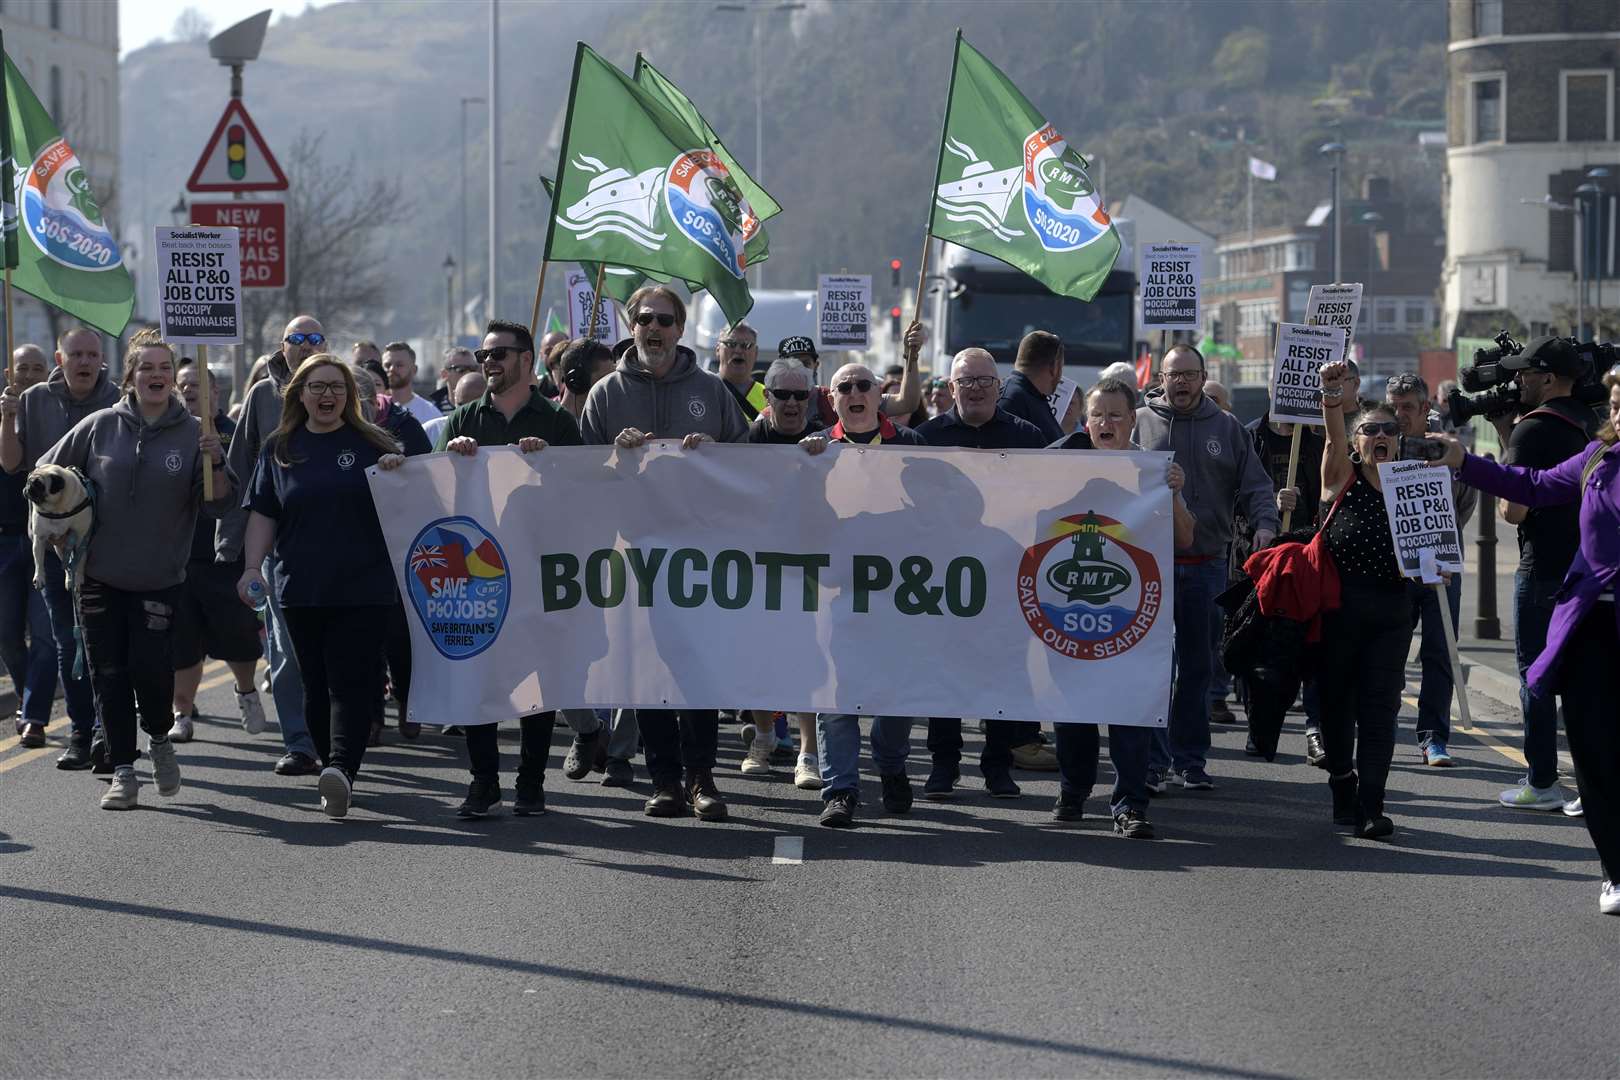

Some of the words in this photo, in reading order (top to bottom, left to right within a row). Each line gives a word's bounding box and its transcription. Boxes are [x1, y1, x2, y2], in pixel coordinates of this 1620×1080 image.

[1040, 129, 1058, 143] OU
[36, 144, 67, 177] SAVE
[1049, 167, 1085, 188] RMT
[216, 210, 260, 224] NEW
[682, 210, 714, 236] SOS
[240, 227, 276, 242] FFIC
[1047, 218, 1080, 244] 2020
[36, 216, 70, 244] SOS
[69, 232, 111, 265] 2020
[171, 252, 224, 267] RESIST
[1152, 262, 1191, 272] RESIST
[167, 269, 193, 284] ALL
[197, 270, 230, 284] P&O
[1147, 274, 1166, 285] ALL
[1168, 274, 1193, 285] P&O
[164, 286, 191, 301] JOB
[195, 286, 235, 301] CUTS
[828, 290, 862, 300] RESIST
[1144, 287, 1164, 297] JOB
[1166, 287, 1196, 297] CUTS
[175, 304, 212, 315] OCCUPY
[824, 302, 840, 311] ALL
[843, 302, 864, 312] P&O
[1318, 303, 1353, 314] RESIST
[175, 316, 235, 326] NATIONALISE
[822, 312, 839, 322] JOB
[841, 312, 866, 322] CUTS
[1331, 315, 1352, 326] P&O
[1292, 328, 1314, 336] Socialist
[1315, 329, 1332, 337] Worker
[790, 342, 803, 352] ALI
[1288, 344, 1332, 361] RESIST
[1281, 358, 1304, 373] ALL
[1307, 360, 1321, 374] P&
[1277, 372, 1300, 386] JOB
[1303, 375, 1320, 388] CU
[1283, 389, 1316, 398] OCCUPY
[1282, 398, 1322, 409] NATIONALI
[1392, 464, 1418, 474] Socialist
[1396, 482, 1443, 501] RESIST
[1395, 502, 1421, 518] ALL
[1423, 498, 1449, 514] P&O
[1395, 518, 1421, 535] JOB
[1424, 514, 1453, 530] CUTS
[1407, 533, 1442, 547] OCCUPY
[540, 547, 830, 613] BOYCOTT
[852, 555, 988, 617] P&O
[1066, 571, 1114, 586] RMT
[430, 577, 467, 599] SAVE
[426, 600, 453, 619] P&O
[454, 599, 498, 619] JOBS
[1020, 575, 1041, 622] SAVE
[1043, 628, 1079, 656] OUR
[1094, 581, 1159, 658] SEAFARERS
[432, 623, 449, 633] SAVE
[450, 622, 495, 634] BRITAIN'S
[1064, 613, 1113, 633] SOS
[444, 636, 474, 646] FERRIES
